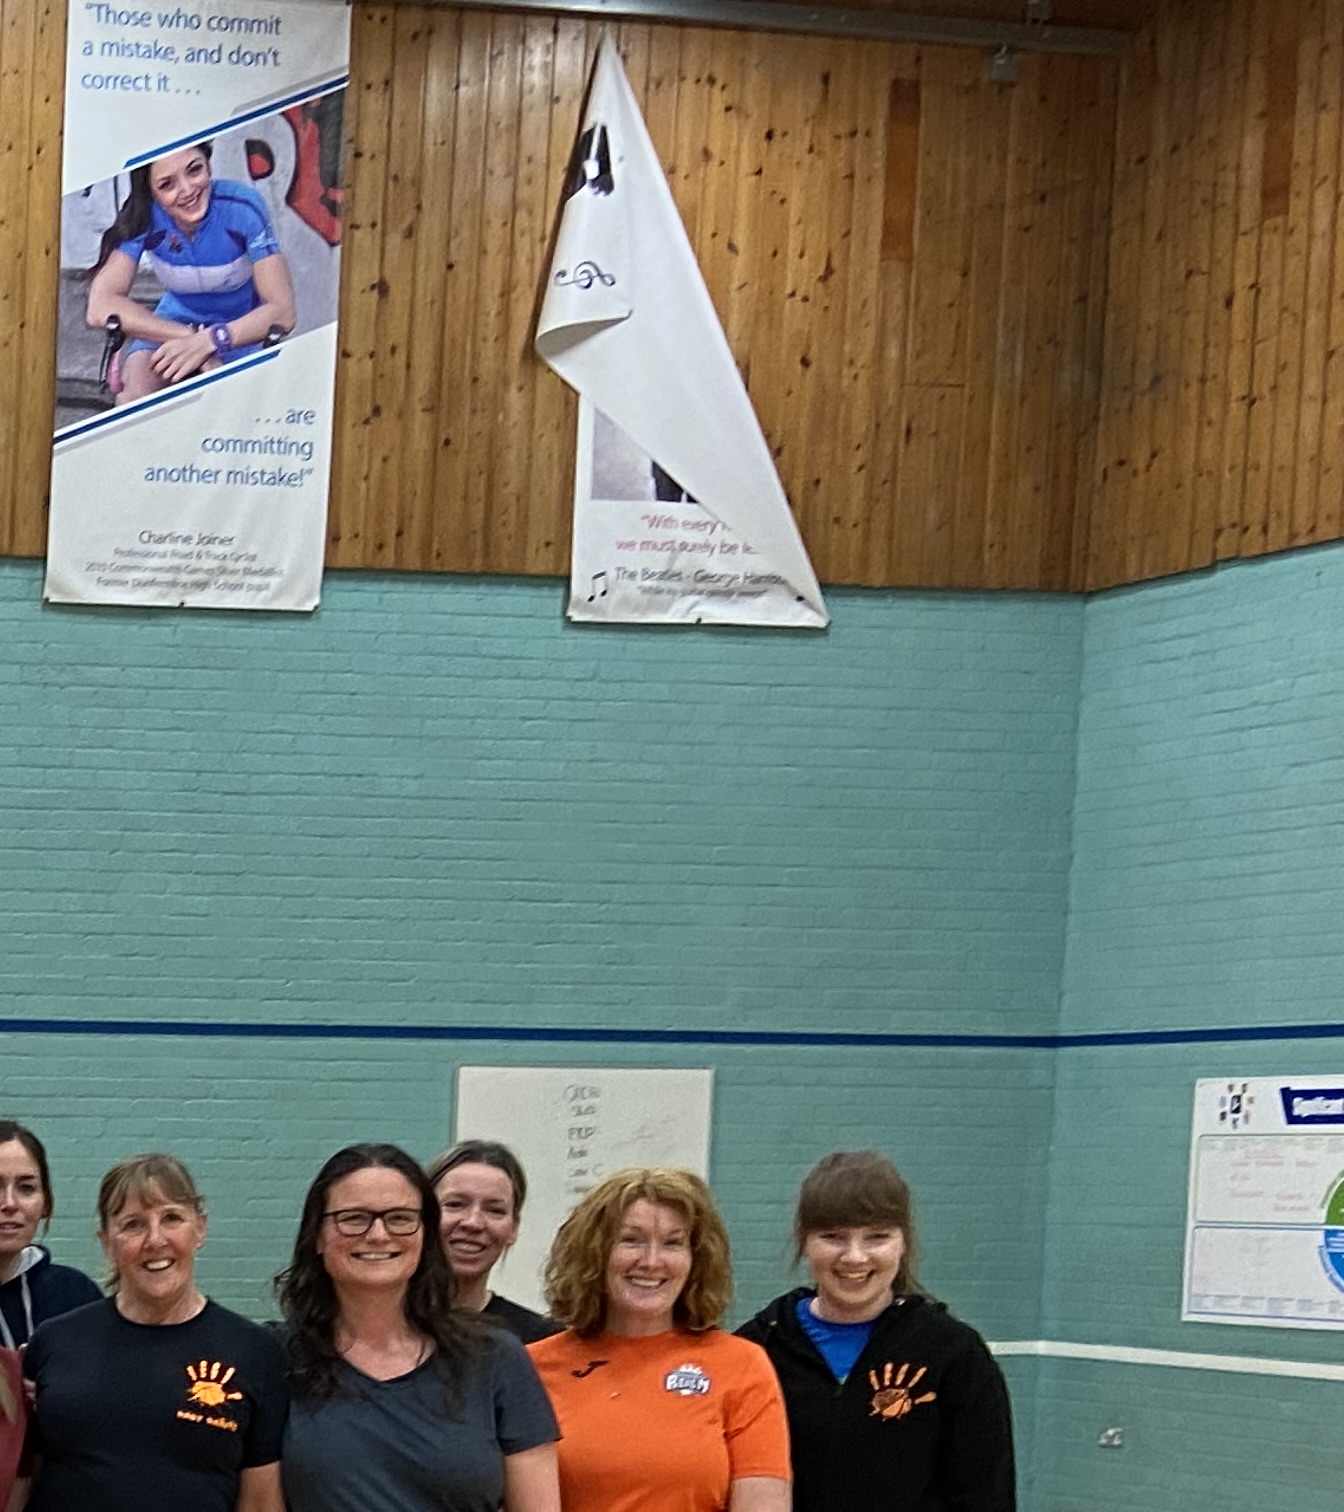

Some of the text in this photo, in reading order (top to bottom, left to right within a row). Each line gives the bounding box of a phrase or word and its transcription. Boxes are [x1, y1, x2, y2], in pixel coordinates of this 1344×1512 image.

[84, 3, 282, 36] "Those who commit
[82, 37, 282, 67] a mistake, and don't
[80, 73, 152, 91] correct
[157, 72, 170, 93] it
[285, 408, 316, 425] are
[201, 434, 315, 461] committing
[144, 464, 314, 488] another mistake!"
